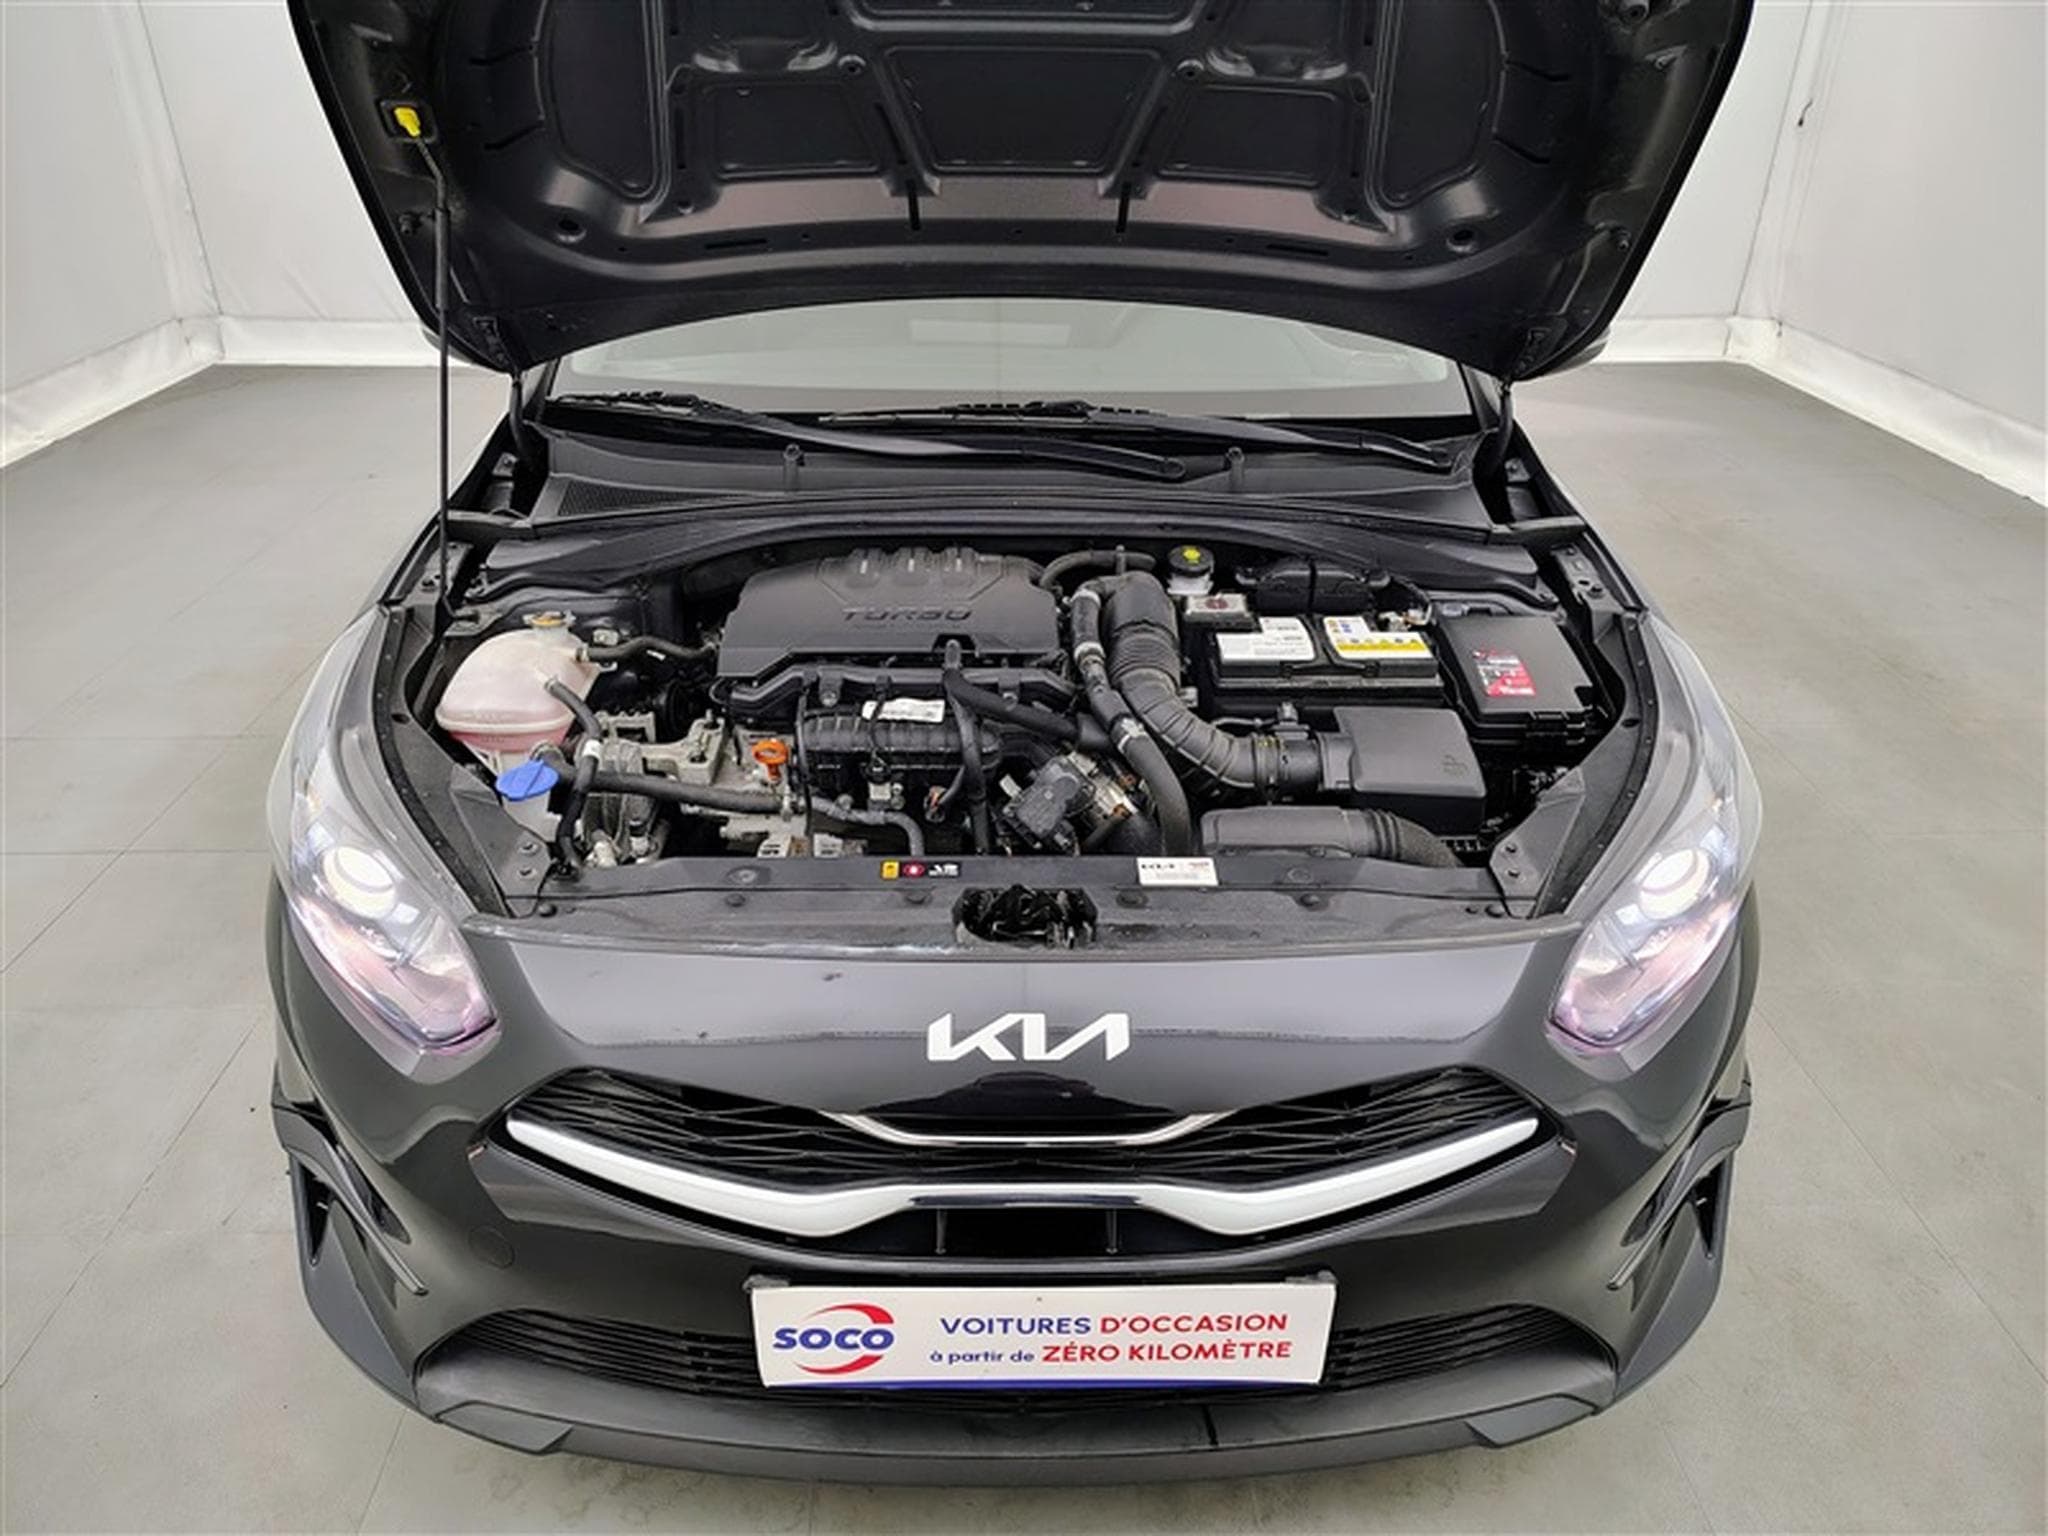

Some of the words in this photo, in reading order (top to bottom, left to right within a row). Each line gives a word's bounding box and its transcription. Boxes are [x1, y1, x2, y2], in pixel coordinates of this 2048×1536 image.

[842, 605, 973, 622] TURBO
[940, 1317, 1091, 1335] VOITURES
[1100, 1314, 1288, 1334] D'OCCASION
[773, 1328, 894, 1350] SOCO
[930, 1350, 943, 1363] à
[949, 1350, 1003, 1365] partir
[1010, 1350, 1035, 1363] de
[1042, 1341, 1120, 1362] ZÉRO
[1128, 1339, 1292, 1361] KILOMÈTRE
